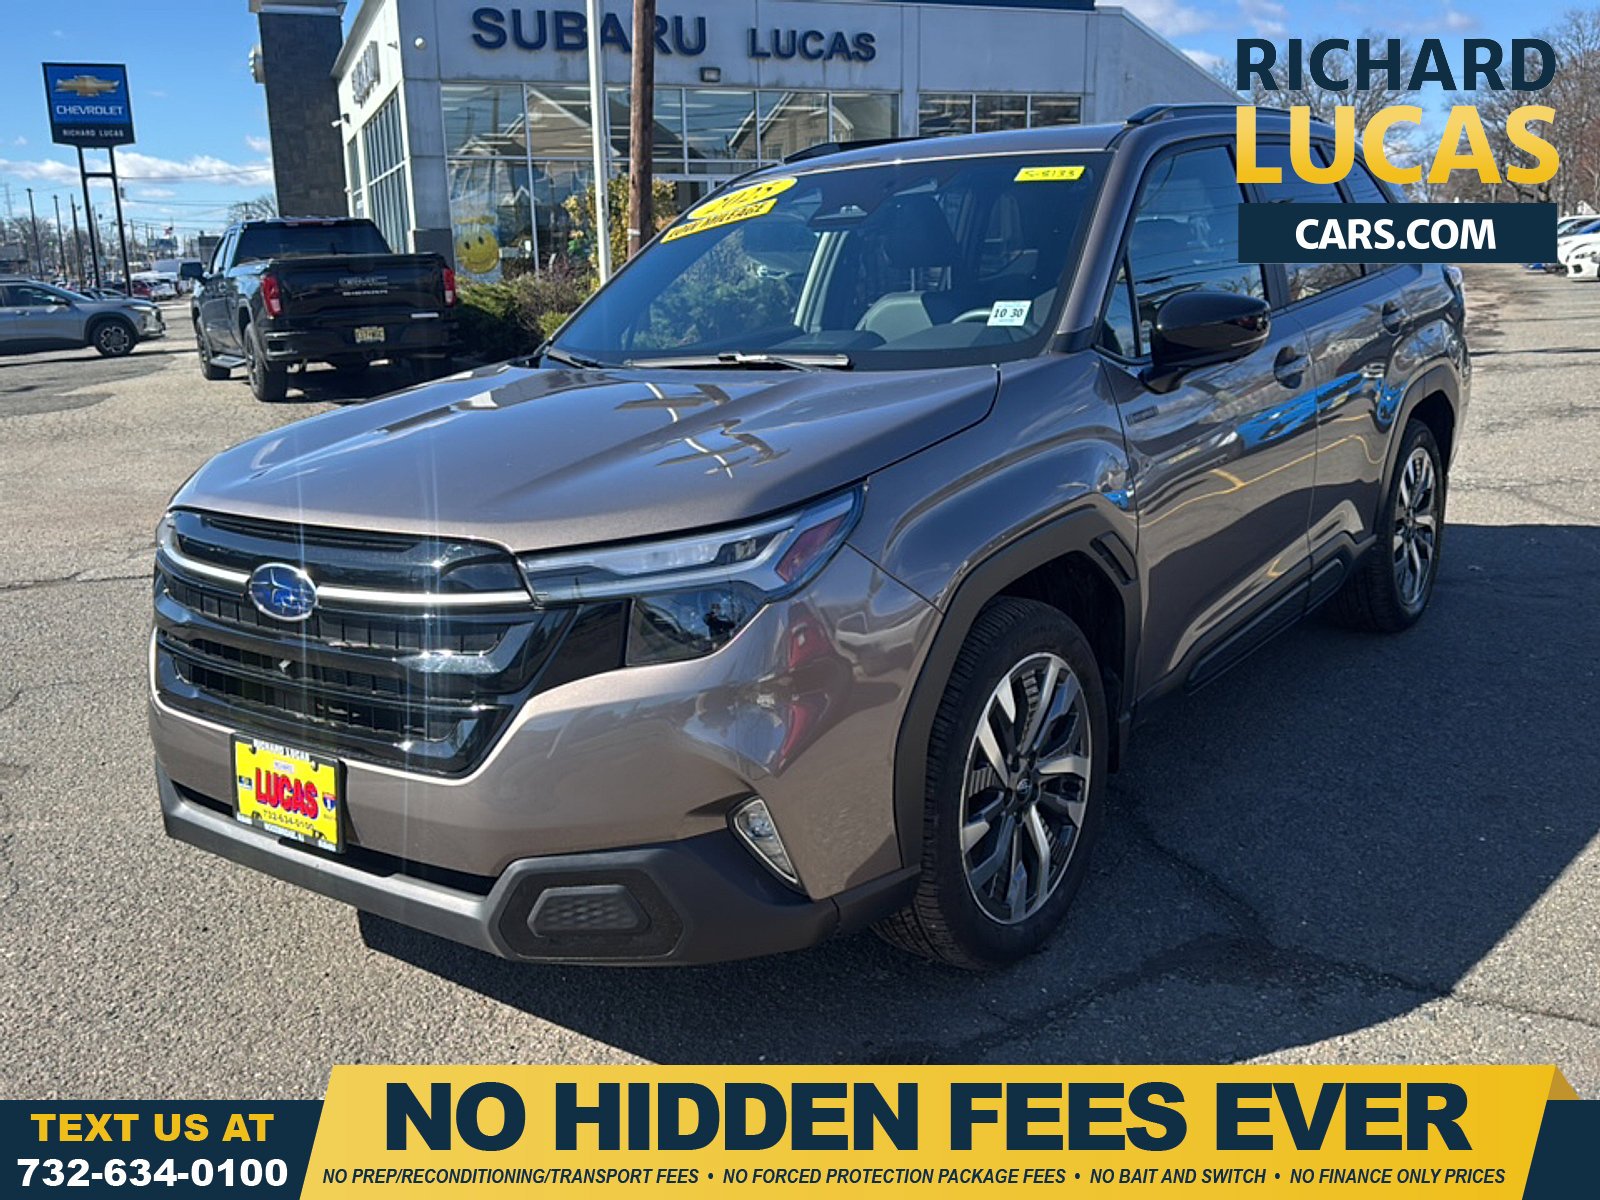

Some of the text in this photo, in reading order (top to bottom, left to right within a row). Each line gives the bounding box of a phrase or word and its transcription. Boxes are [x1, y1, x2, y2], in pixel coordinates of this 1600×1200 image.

[747, 28, 877, 62] LUCAS
[56, 105, 124, 115] CHEVROLET
[63, 129, 124, 137] RICHARD LUCAS
[255, 767, 319, 820] LUCAS
